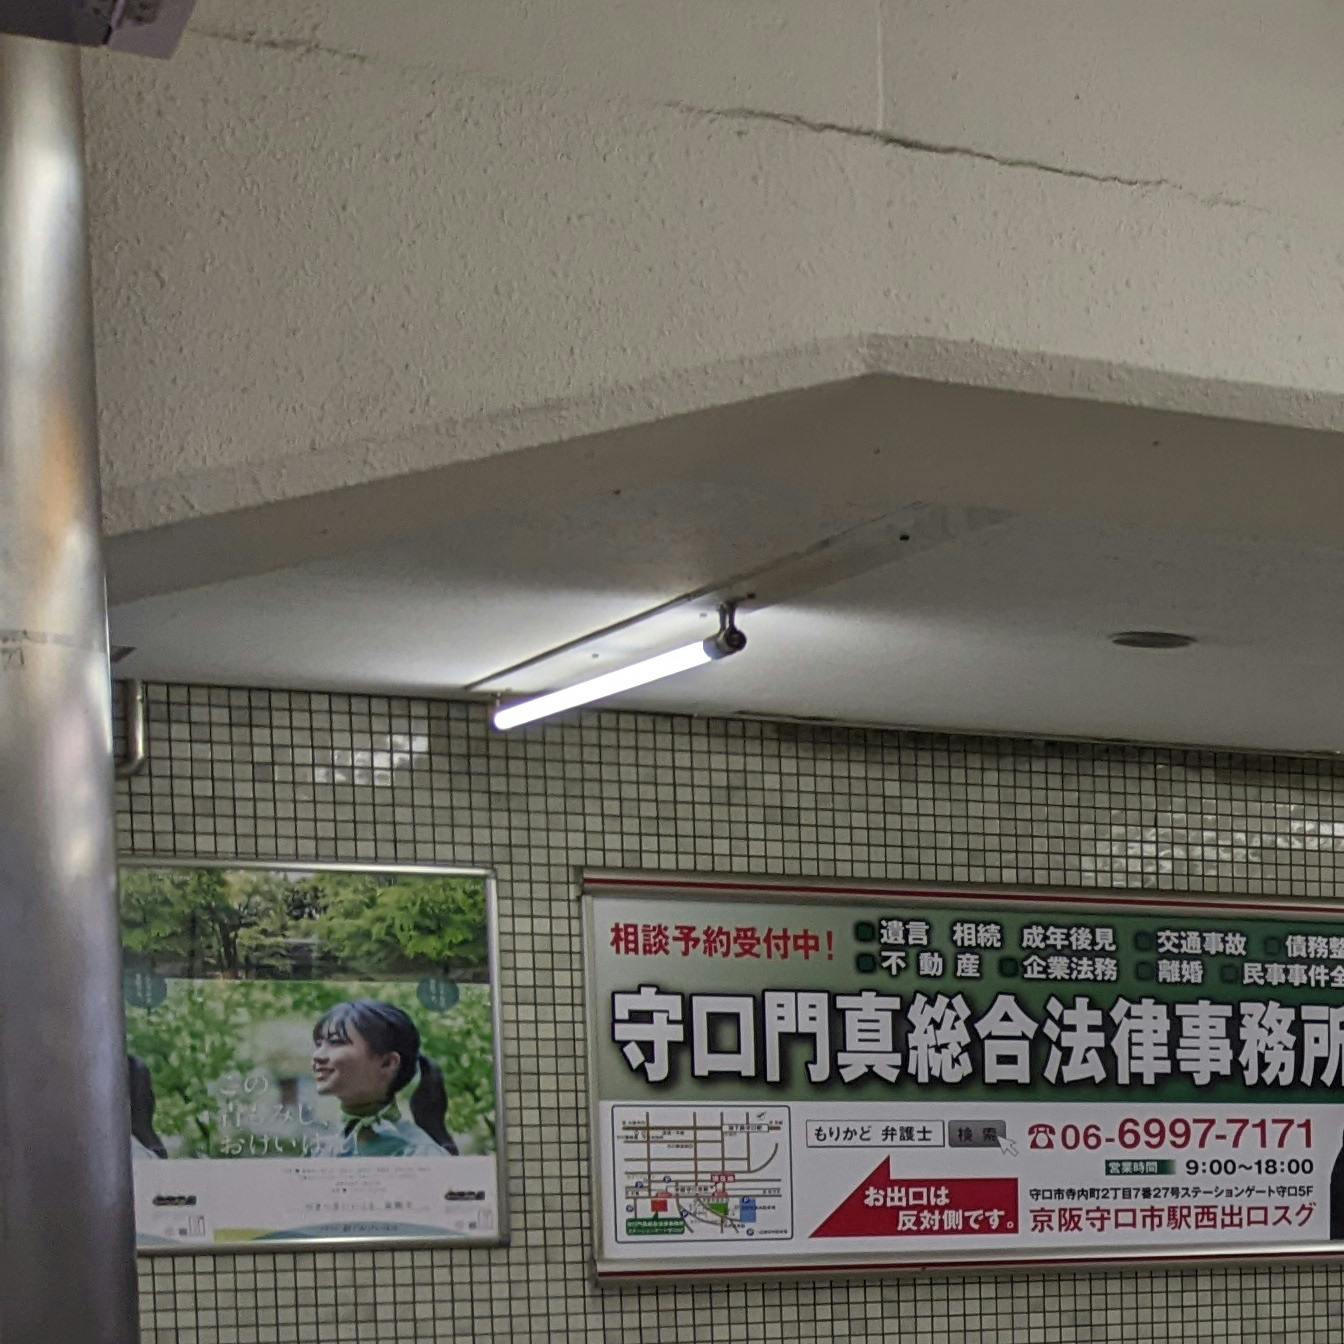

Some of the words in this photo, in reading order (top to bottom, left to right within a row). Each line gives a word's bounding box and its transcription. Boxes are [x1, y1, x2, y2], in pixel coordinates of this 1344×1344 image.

[611, 922, 834, 961] 相談予約受付中!
[880, 919, 930, 946] 遺言
[953, 922, 1002, 948] 相続
[1022, 925, 1118, 951] 成年後見
[1157, 929, 1248, 956] 交通事故
[881, 950, 982, 978] 不動産
[1023, 955, 1119, 981] 企業法務
[1157, 959, 1205, 984] 離婚
[814, 1126, 872, 1142] もりかど
[881, 1126, 933, 1142] 弁護士
[1060, 1118, 1313, 1150] 06-6997-7171
[864, 1186, 950, 1208] お出口は
[897, 1208, 1015, 1231] 反対側です。
[1030, 1202, 1316, 1233] 京阪守口市駅西出口スグ
